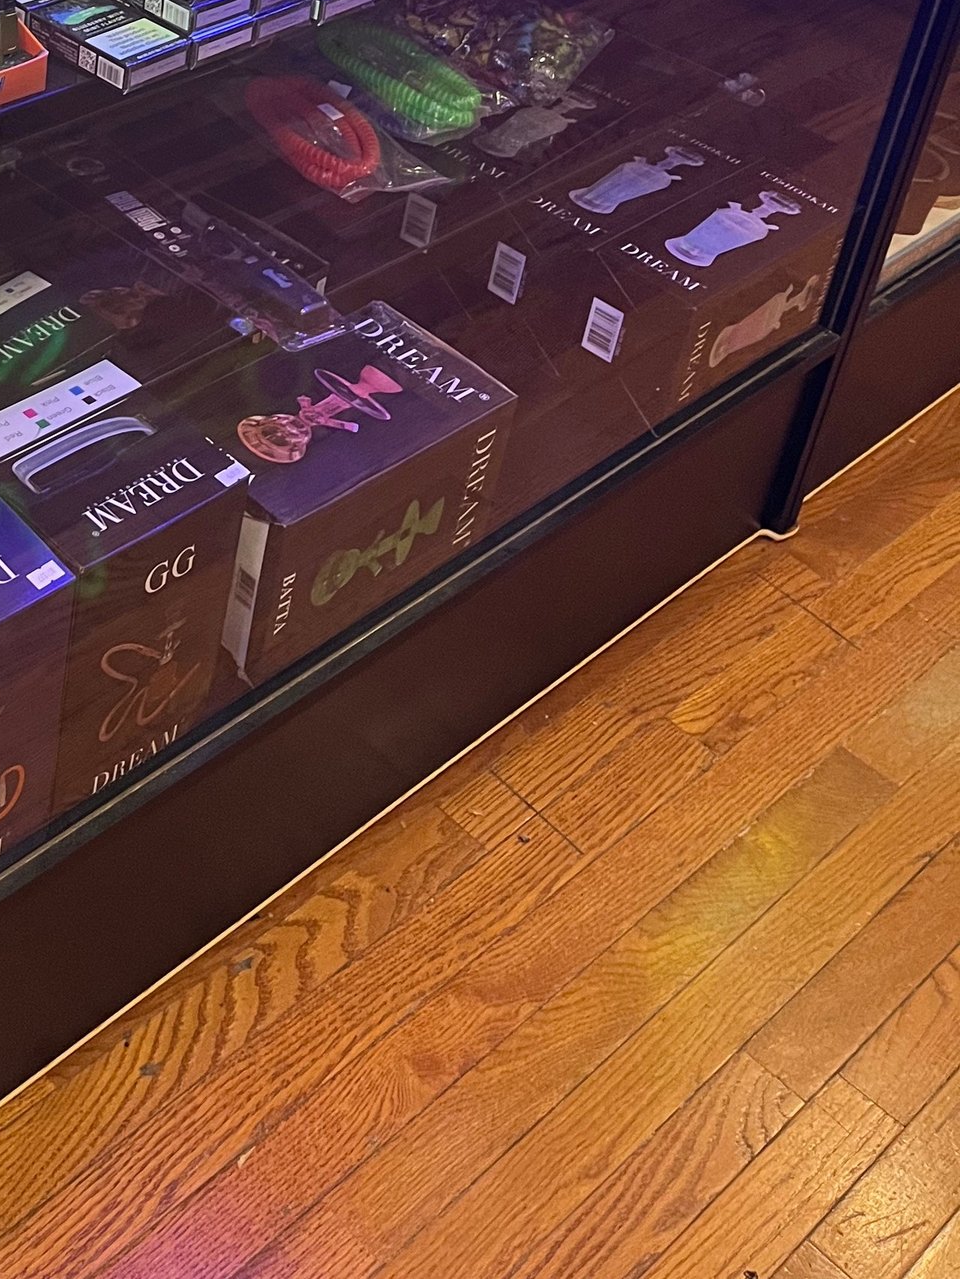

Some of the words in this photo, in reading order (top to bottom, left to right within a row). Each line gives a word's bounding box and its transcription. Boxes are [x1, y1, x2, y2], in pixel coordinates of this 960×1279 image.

[620, 242, 703, 293] DREAM
[83, 374, 104, 387] Blue
[92, 384, 116, 398] Black
[42, 396, 60, 408] Pink
[50, 405, 73, 420] Green
[144, 544, 196, 595] GG
[272, 571, 297, 637] BATTA
